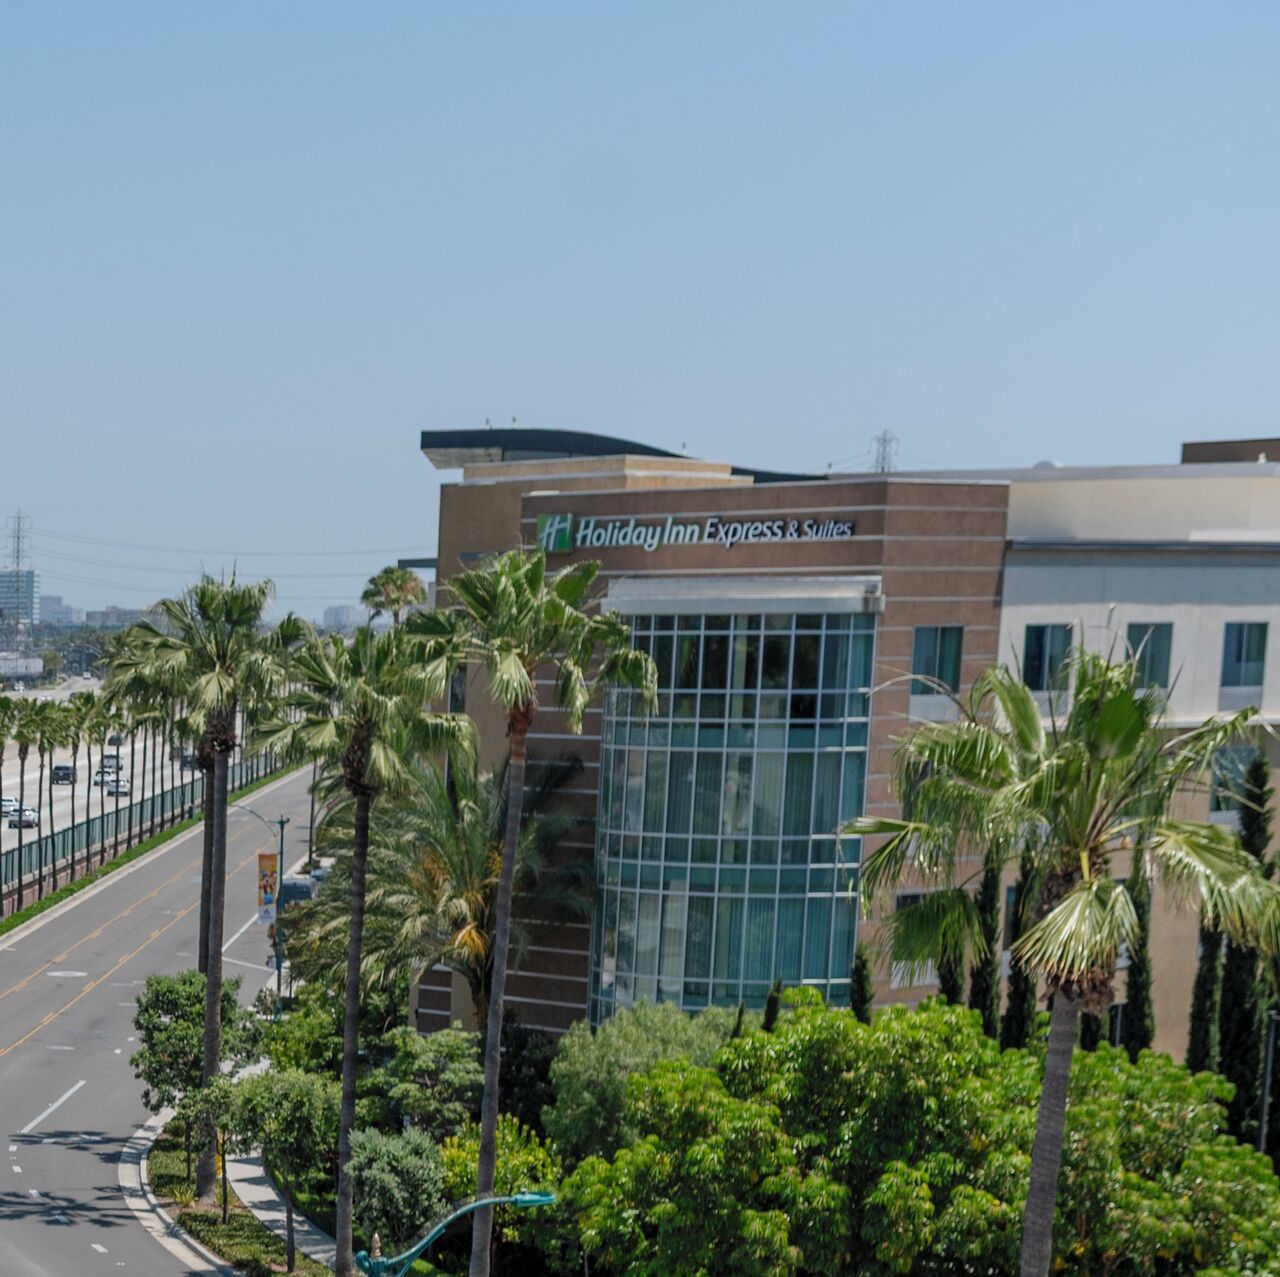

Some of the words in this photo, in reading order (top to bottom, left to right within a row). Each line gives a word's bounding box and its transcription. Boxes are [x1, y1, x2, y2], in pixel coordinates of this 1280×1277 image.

[576, 517, 661, 551] Holiday
[663, 515, 700, 544] Inn
[703, 517, 784, 549] Express
[786, 519, 800, 539] &
[800, 519, 852, 540] Suites
